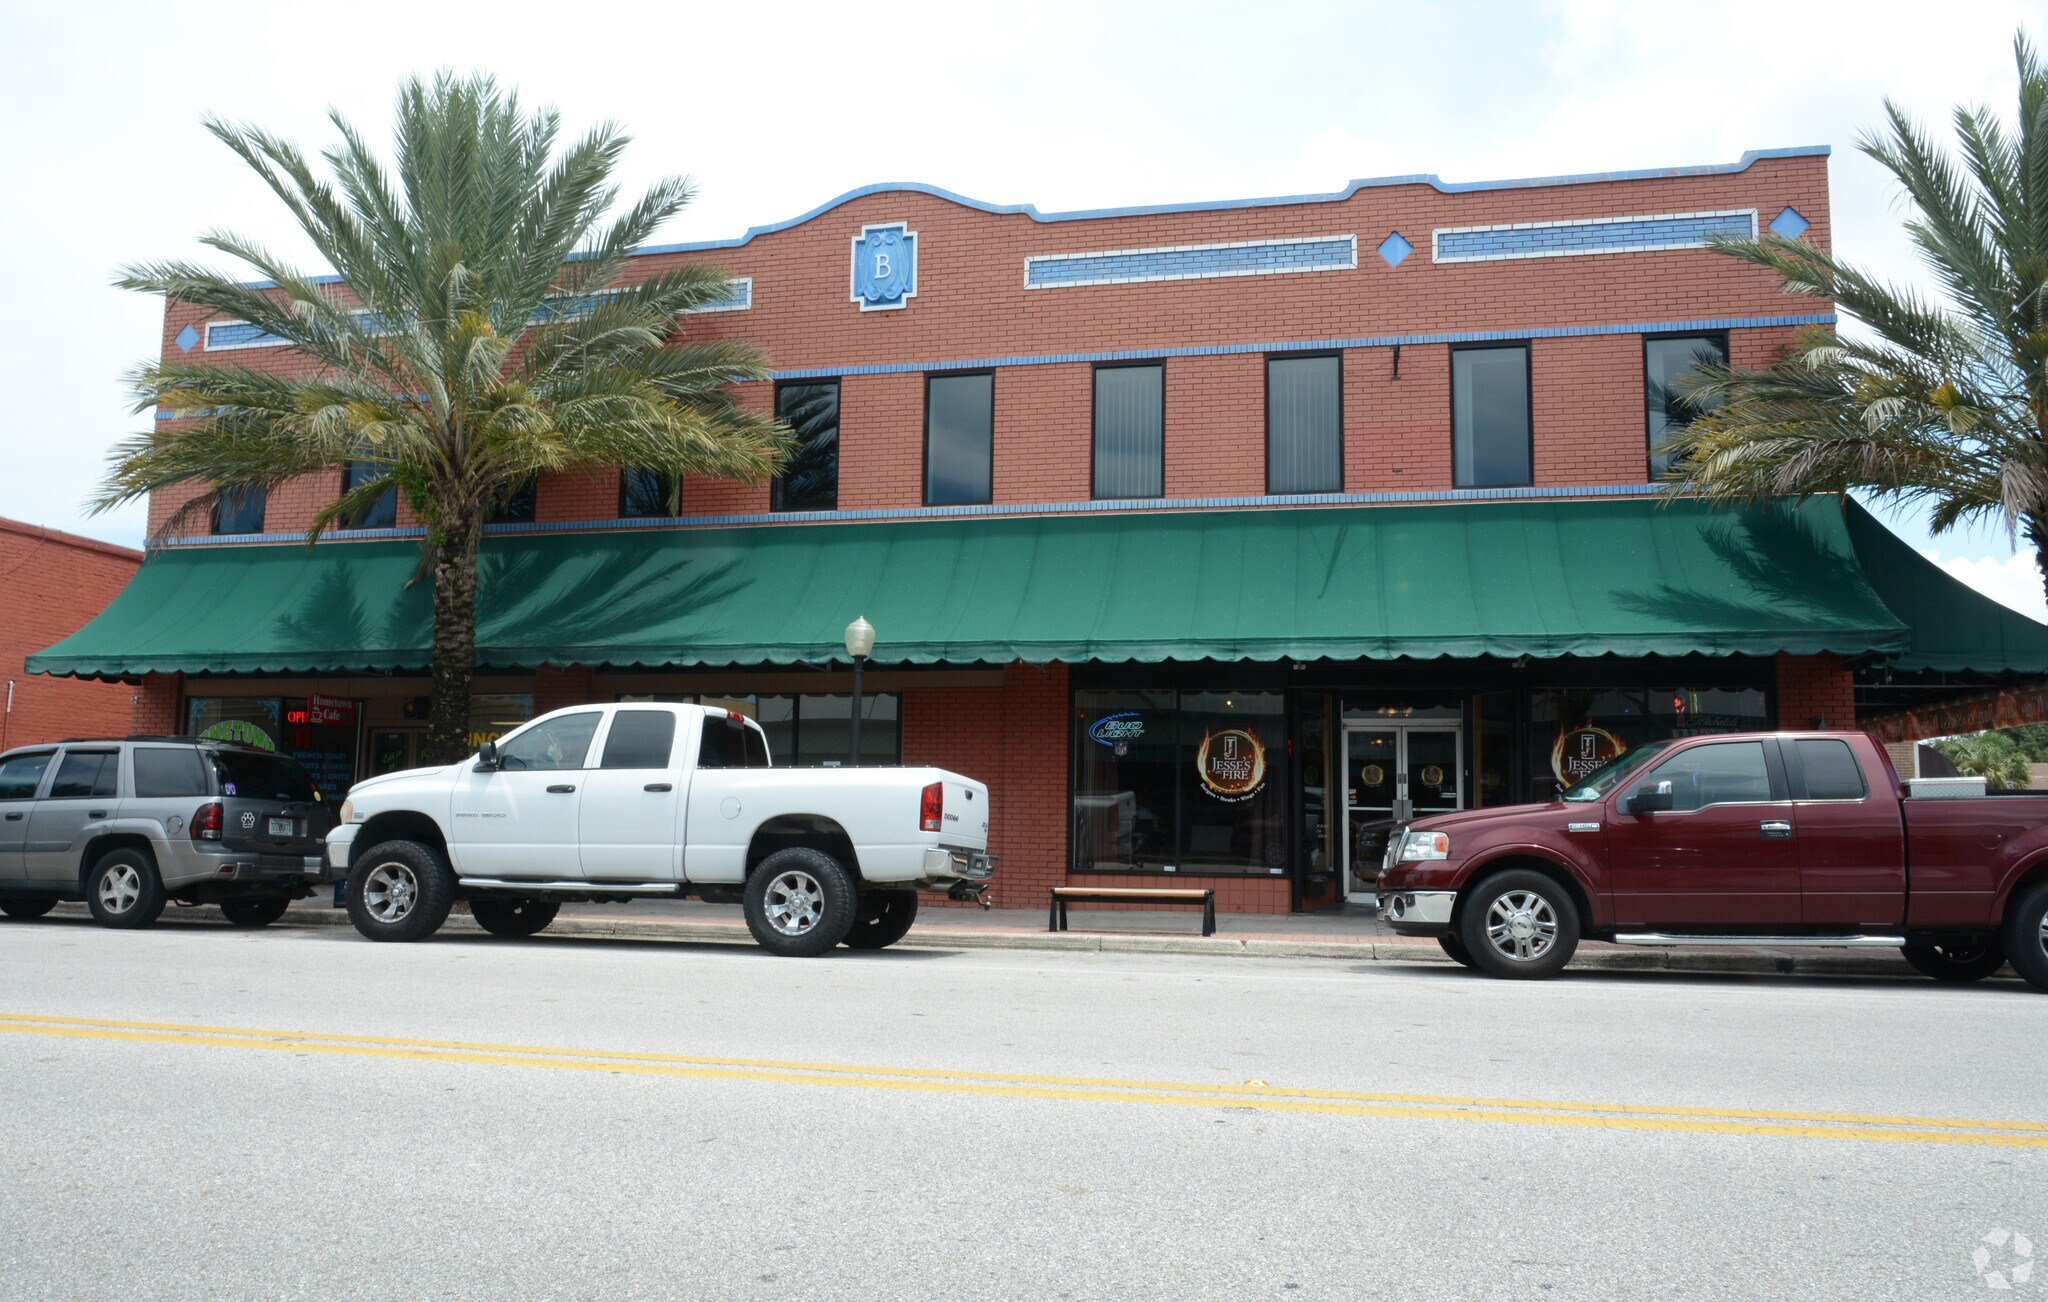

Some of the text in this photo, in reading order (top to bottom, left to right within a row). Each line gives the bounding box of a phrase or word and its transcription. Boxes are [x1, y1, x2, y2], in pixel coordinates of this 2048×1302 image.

[874, 253, 892, 279] B
[313, 694, 352, 709] Hometown
[287, 710, 307, 723] OPE
[323, 709, 341, 721] Cafe
[1105, 720, 1143, 730] BUD
[198, 720, 276, 752] OMETOWN
[1095, 729, 1145, 738] LIGHT
[1222, 771, 1249, 780] FIRE
